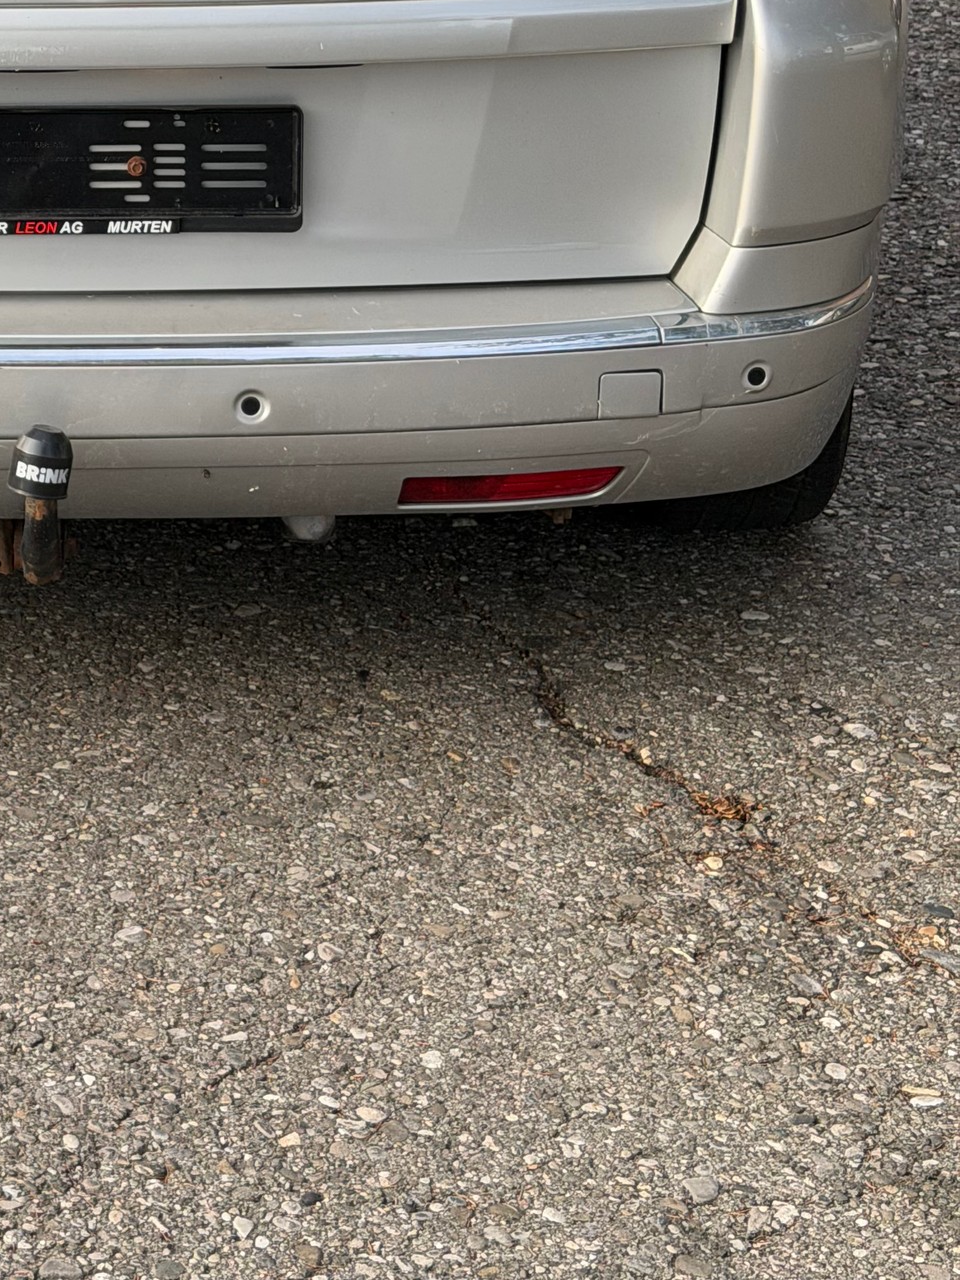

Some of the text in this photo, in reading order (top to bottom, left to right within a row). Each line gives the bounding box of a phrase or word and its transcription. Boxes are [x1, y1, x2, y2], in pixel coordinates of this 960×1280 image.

[15, 221, 58, 235] LEON
[59, 221, 84, 234] AG
[107, 220, 173, 233] MURTEN
